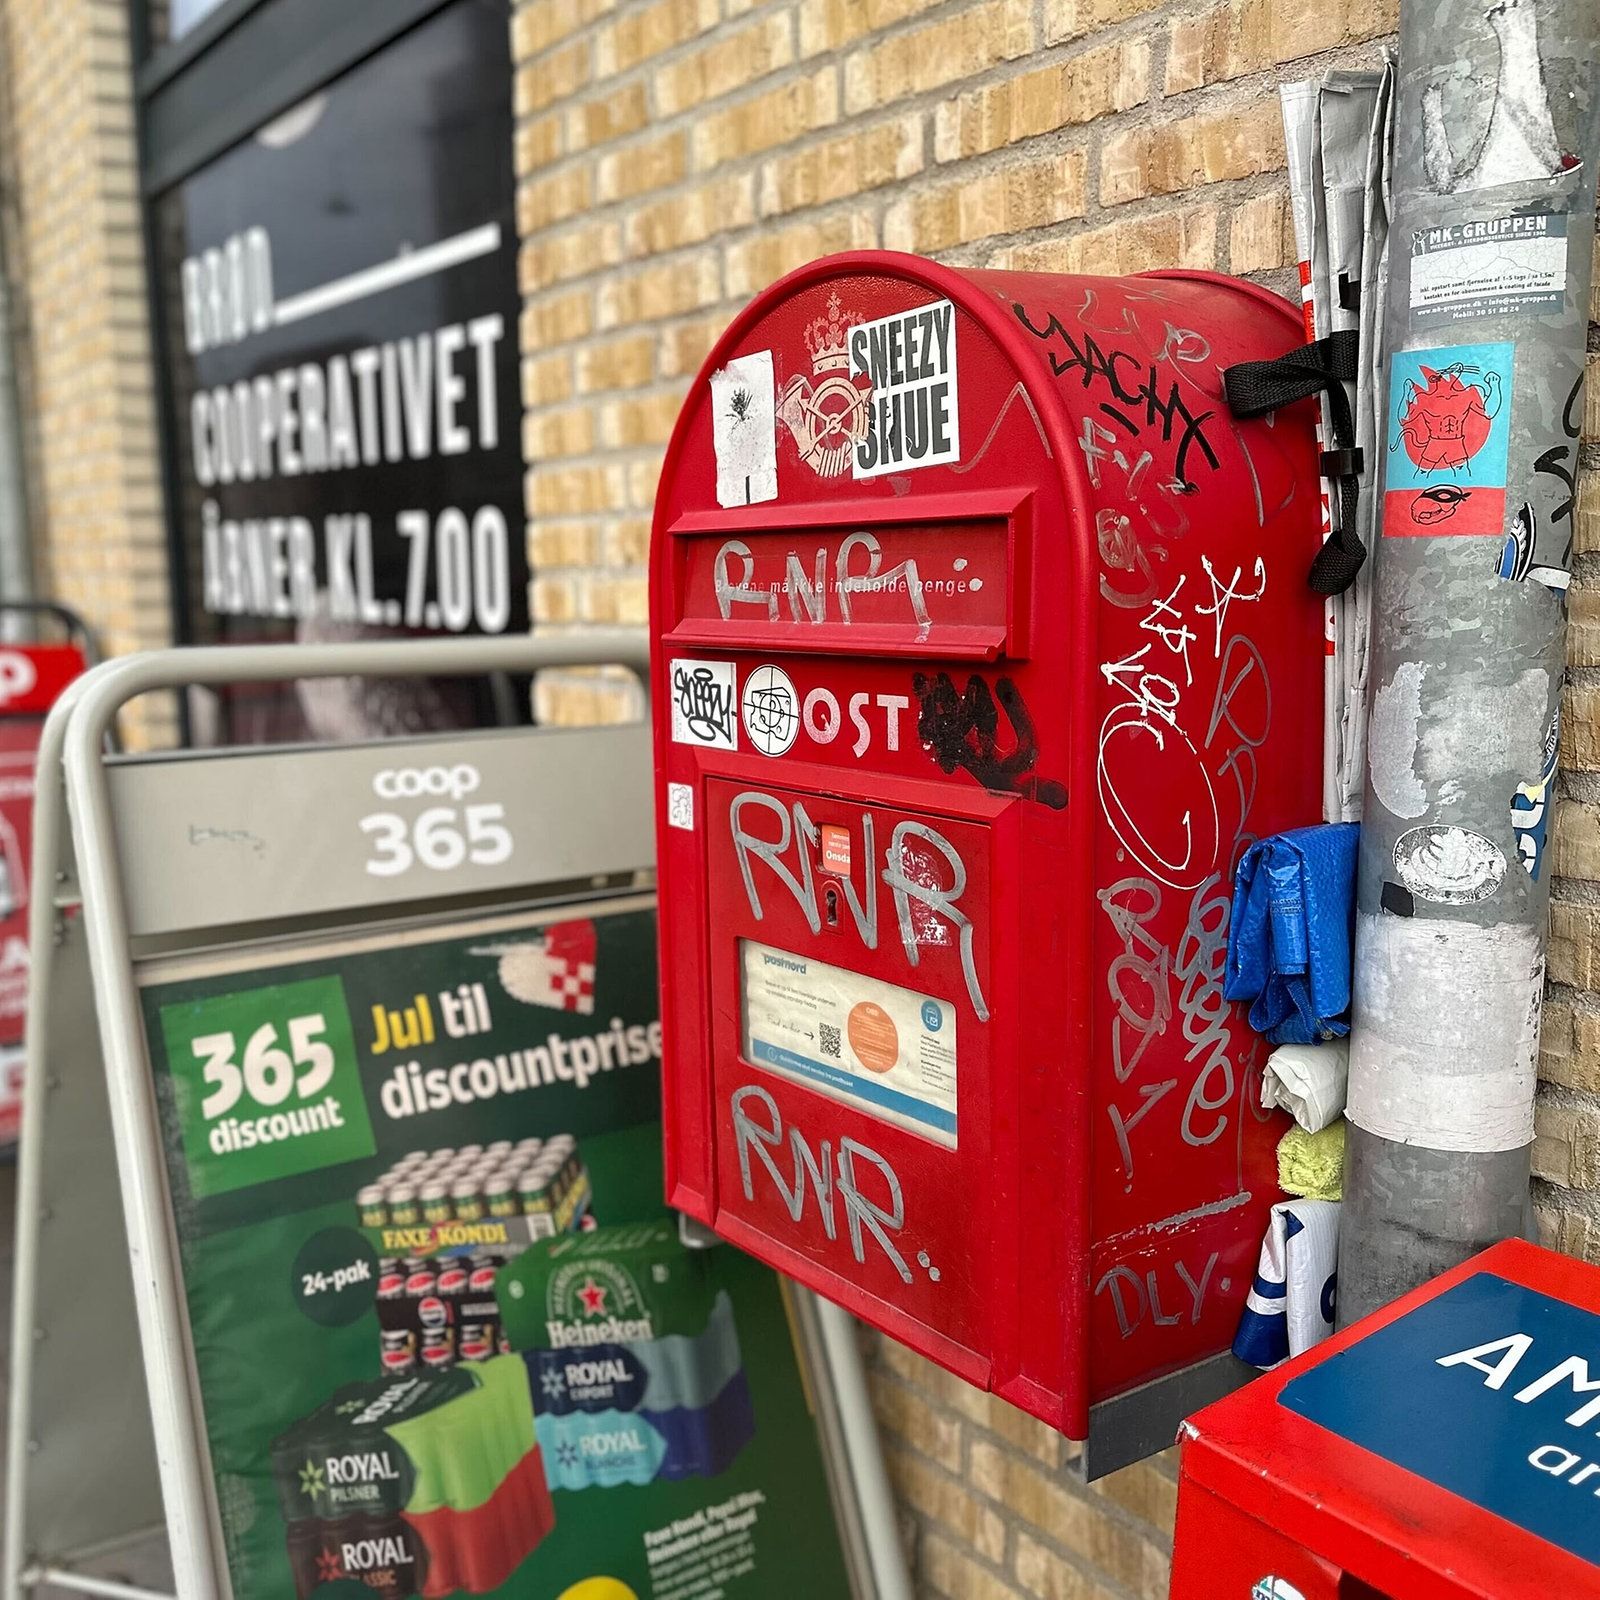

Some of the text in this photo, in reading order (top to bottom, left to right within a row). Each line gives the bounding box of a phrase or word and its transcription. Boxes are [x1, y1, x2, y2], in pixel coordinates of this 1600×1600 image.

[1429, 216, 1547, 244] MK-GRUPPEN
[1461, 286, 1497, 294] abonnement
[1504, 282, 1525, 290] coating
[851, 303, 951, 390] SNEEZY
[190, 313, 503, 487] COOPERATIVET
[202, 498, 317, 618] ÅBNER
[829, 577, 907, 593] indeholde
[914, 579, 966, 597] penge
[373, 764, 480, 800] coop
[359, 803, 513, 876] 365
[371, 984, 491, 1055] Jul til
[192, 1013, 335, 1120] 365
[209, 1097, 344, 1155] discount
[383, 1222, 507, 1250] FAXE KONDI
[301, 1255, 371, 1298] 24-pak
[546, 1311, 653, 1349] Heineken
[565, 1358, 634, 1386] ROYAL
[579, 1429, 646, 1457] ROYAL
[326, 1451, 400, 1483] ROYAL
[330, 1484, 380, 1501] PILSNER
[341, 1536, 414, 1571] ROYAL
[346, 1569, 396, 1587] ASSIC
